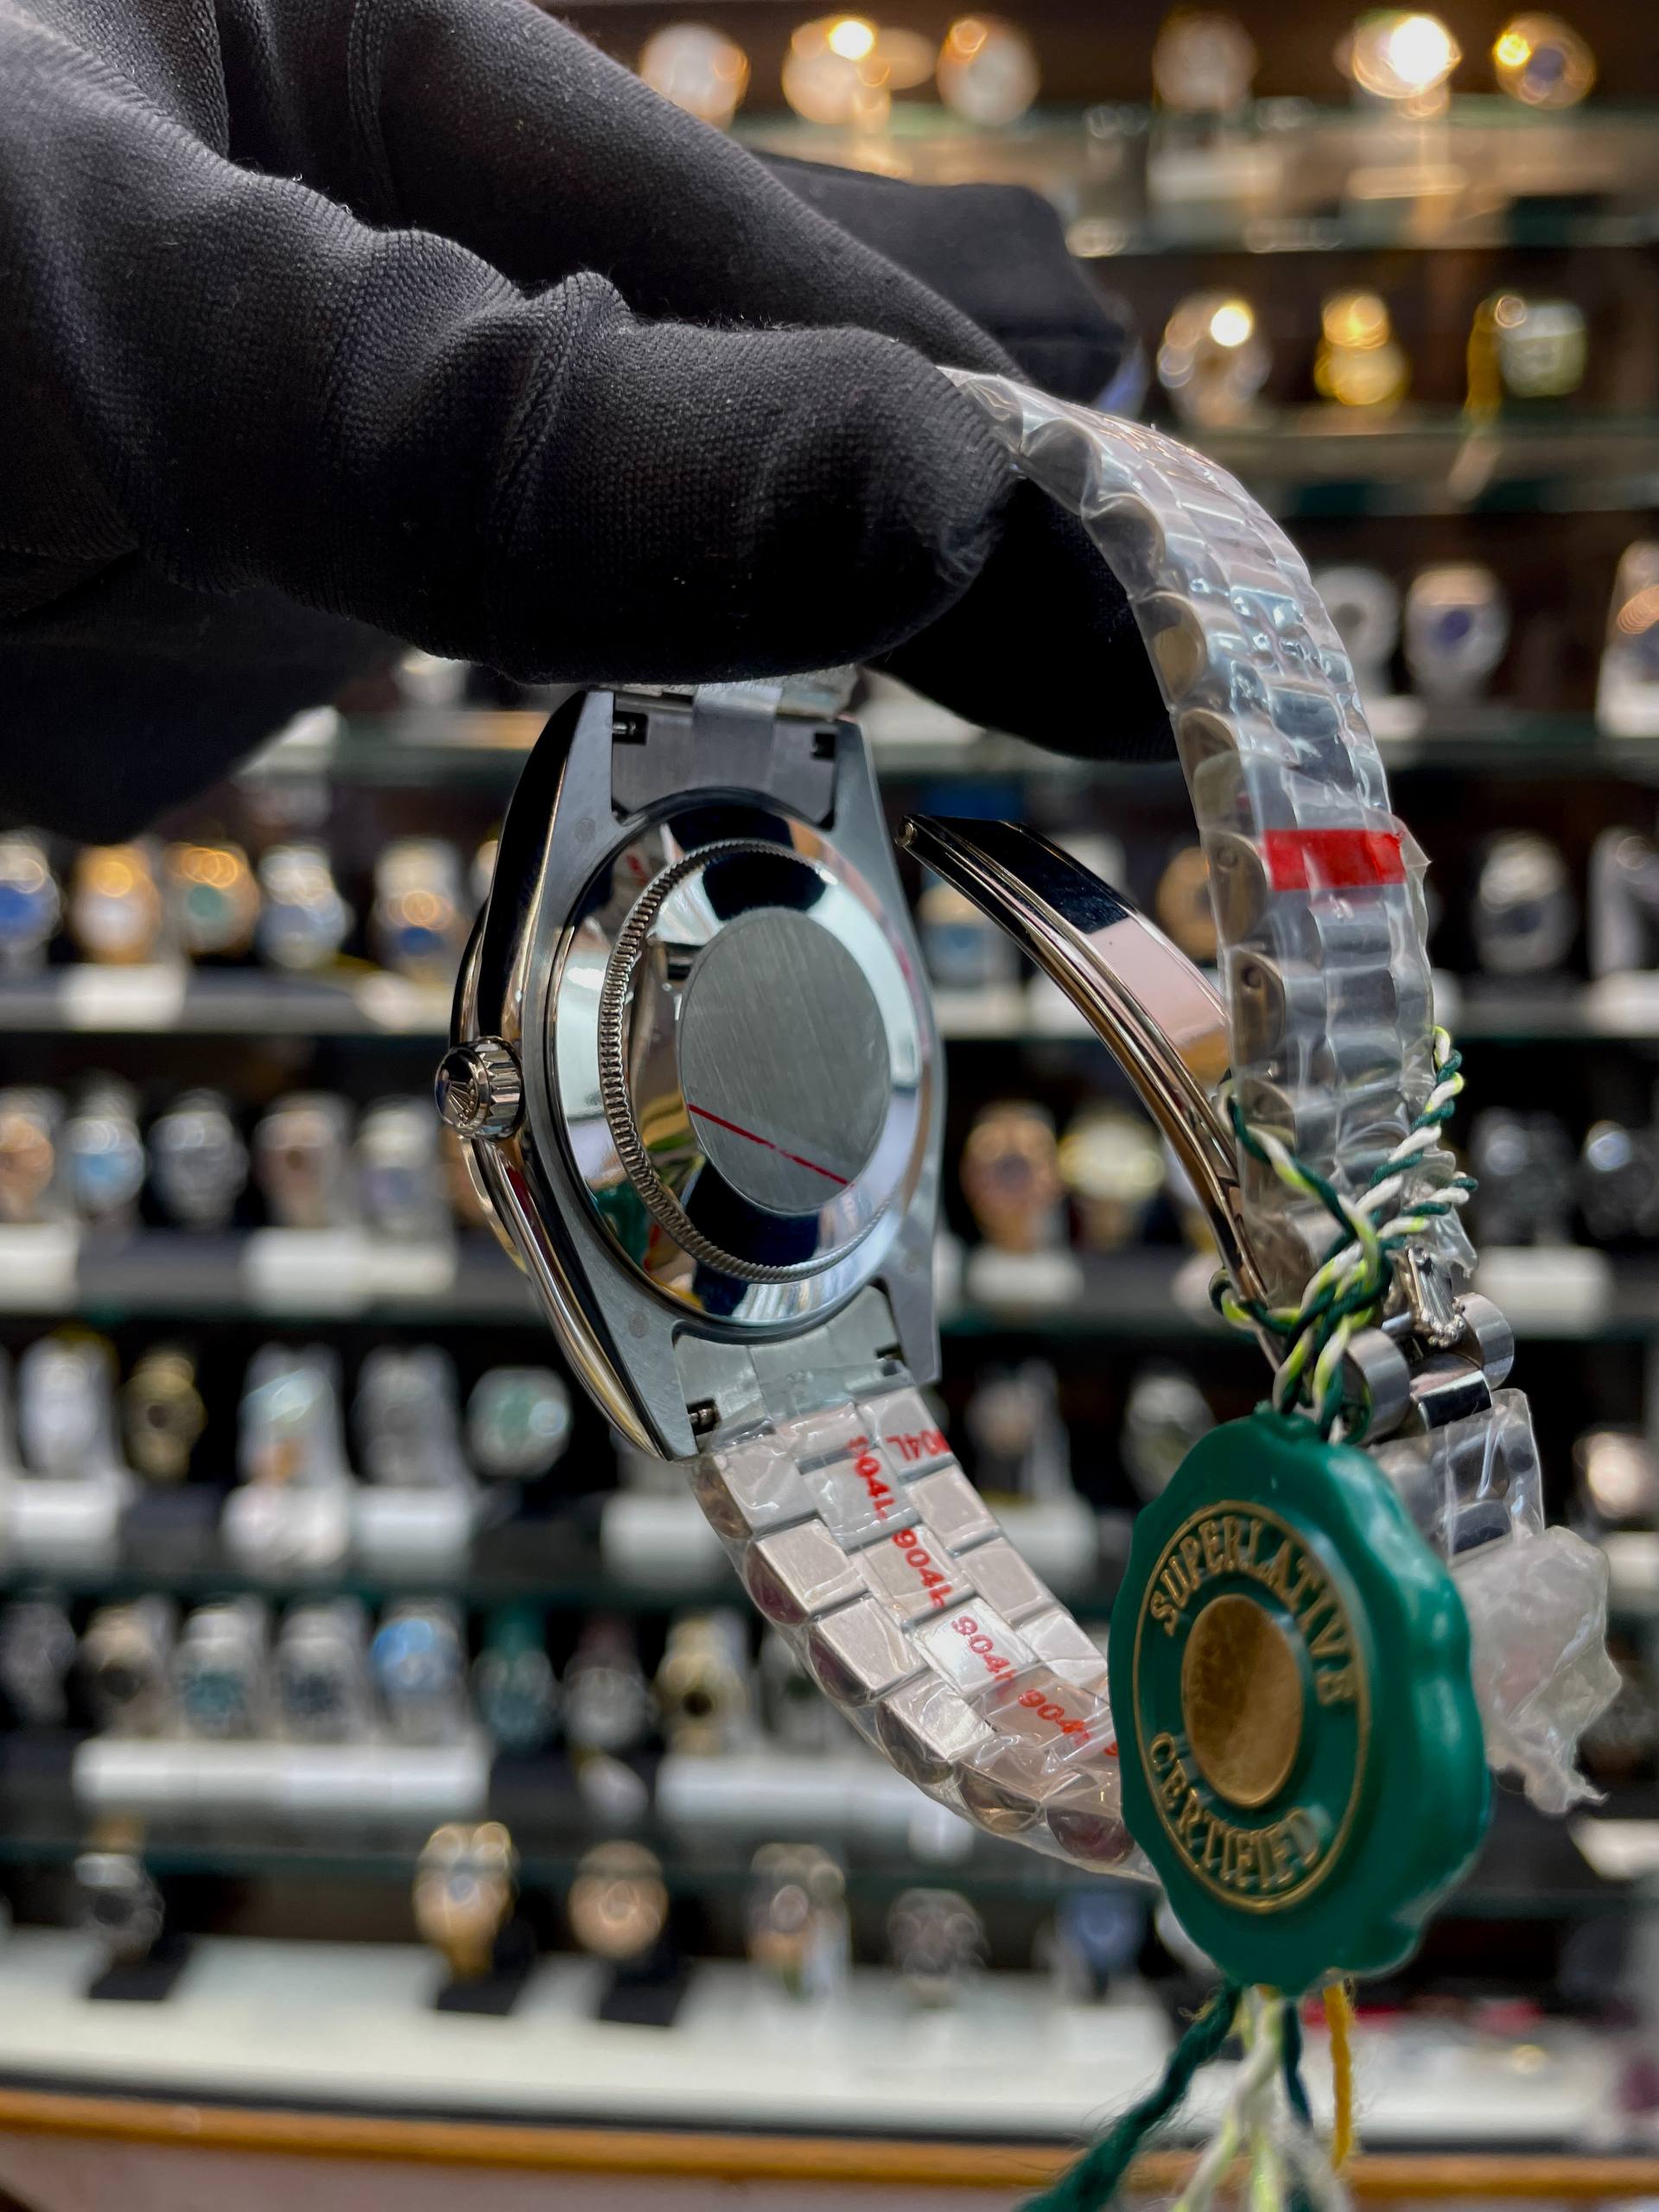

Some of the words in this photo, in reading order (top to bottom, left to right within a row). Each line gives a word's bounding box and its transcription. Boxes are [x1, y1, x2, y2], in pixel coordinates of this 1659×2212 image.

[893, 1528, 954, 1609] 904L
[1150, 1515, 1357, 1707] SUPERLATIVE
[1152, 1732, 1322, 1891] CERTIFIED
